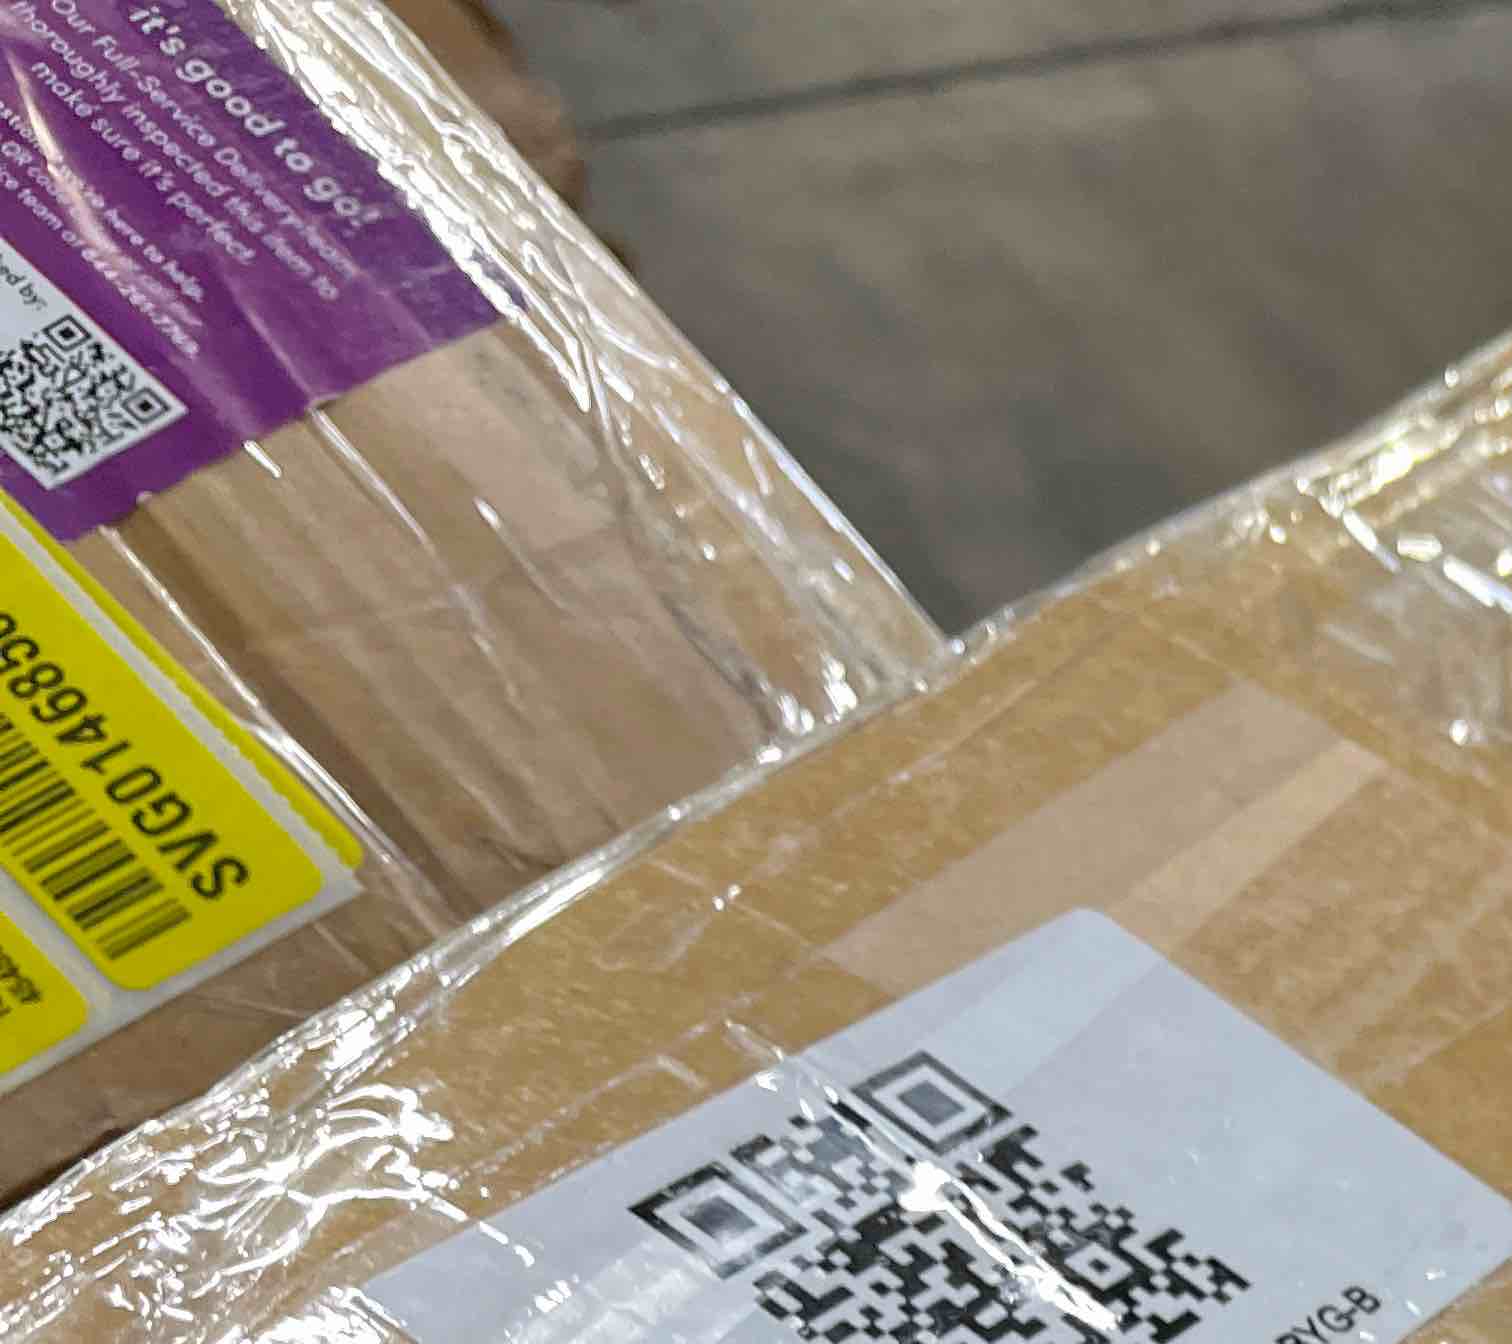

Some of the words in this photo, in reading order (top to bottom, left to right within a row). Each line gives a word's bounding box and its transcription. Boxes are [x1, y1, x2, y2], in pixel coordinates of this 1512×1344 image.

[9, 0, 128, 103] thoroughly
[121, 101, 236, 198] inspected
[31, 61, 95, 118] make
[90, 117, 142, 162] sure
[137, 159, 176, 192] it's
[52, 0, 96, 33] Our
[91, 34, 217, 148] Full-Service
[129, 5, 187, 57] it's
[175, 59, 285, 137] good
[273, 137, 315, 174] to
[303, 175, 383, 240] go!
[103, 208, 145, 247] here
[142, 243, 165, 264] to
